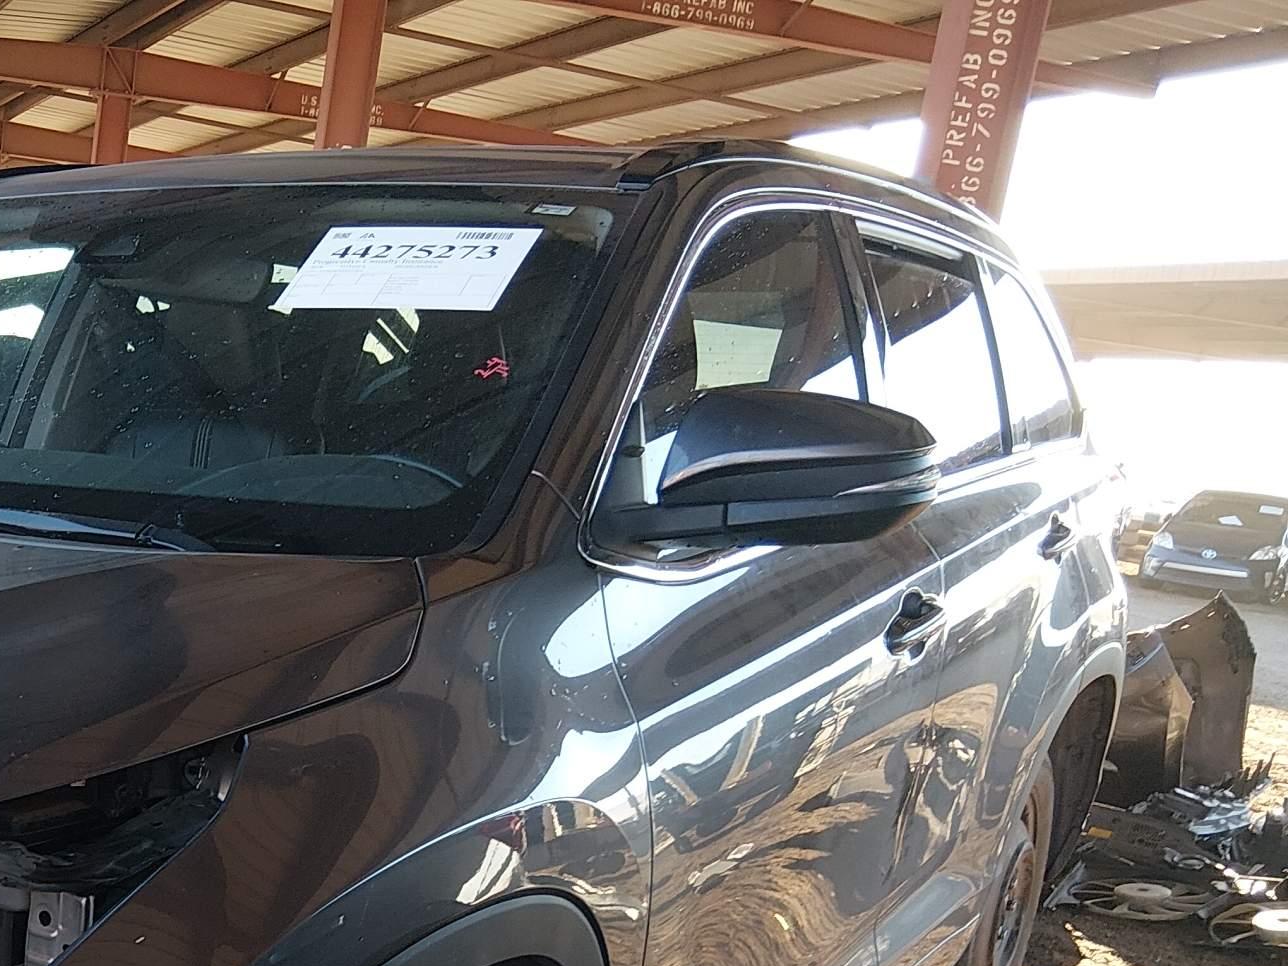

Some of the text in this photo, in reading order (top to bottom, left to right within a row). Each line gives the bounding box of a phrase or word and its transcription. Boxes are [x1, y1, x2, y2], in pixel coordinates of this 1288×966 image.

[641, 0, 755, 30] 1-866-799-0969
[941, 52, 983, 165] PREFAB
[959, 0, 1021, 206] 66-799-096
[330, 244, 500, 260] 44275273
